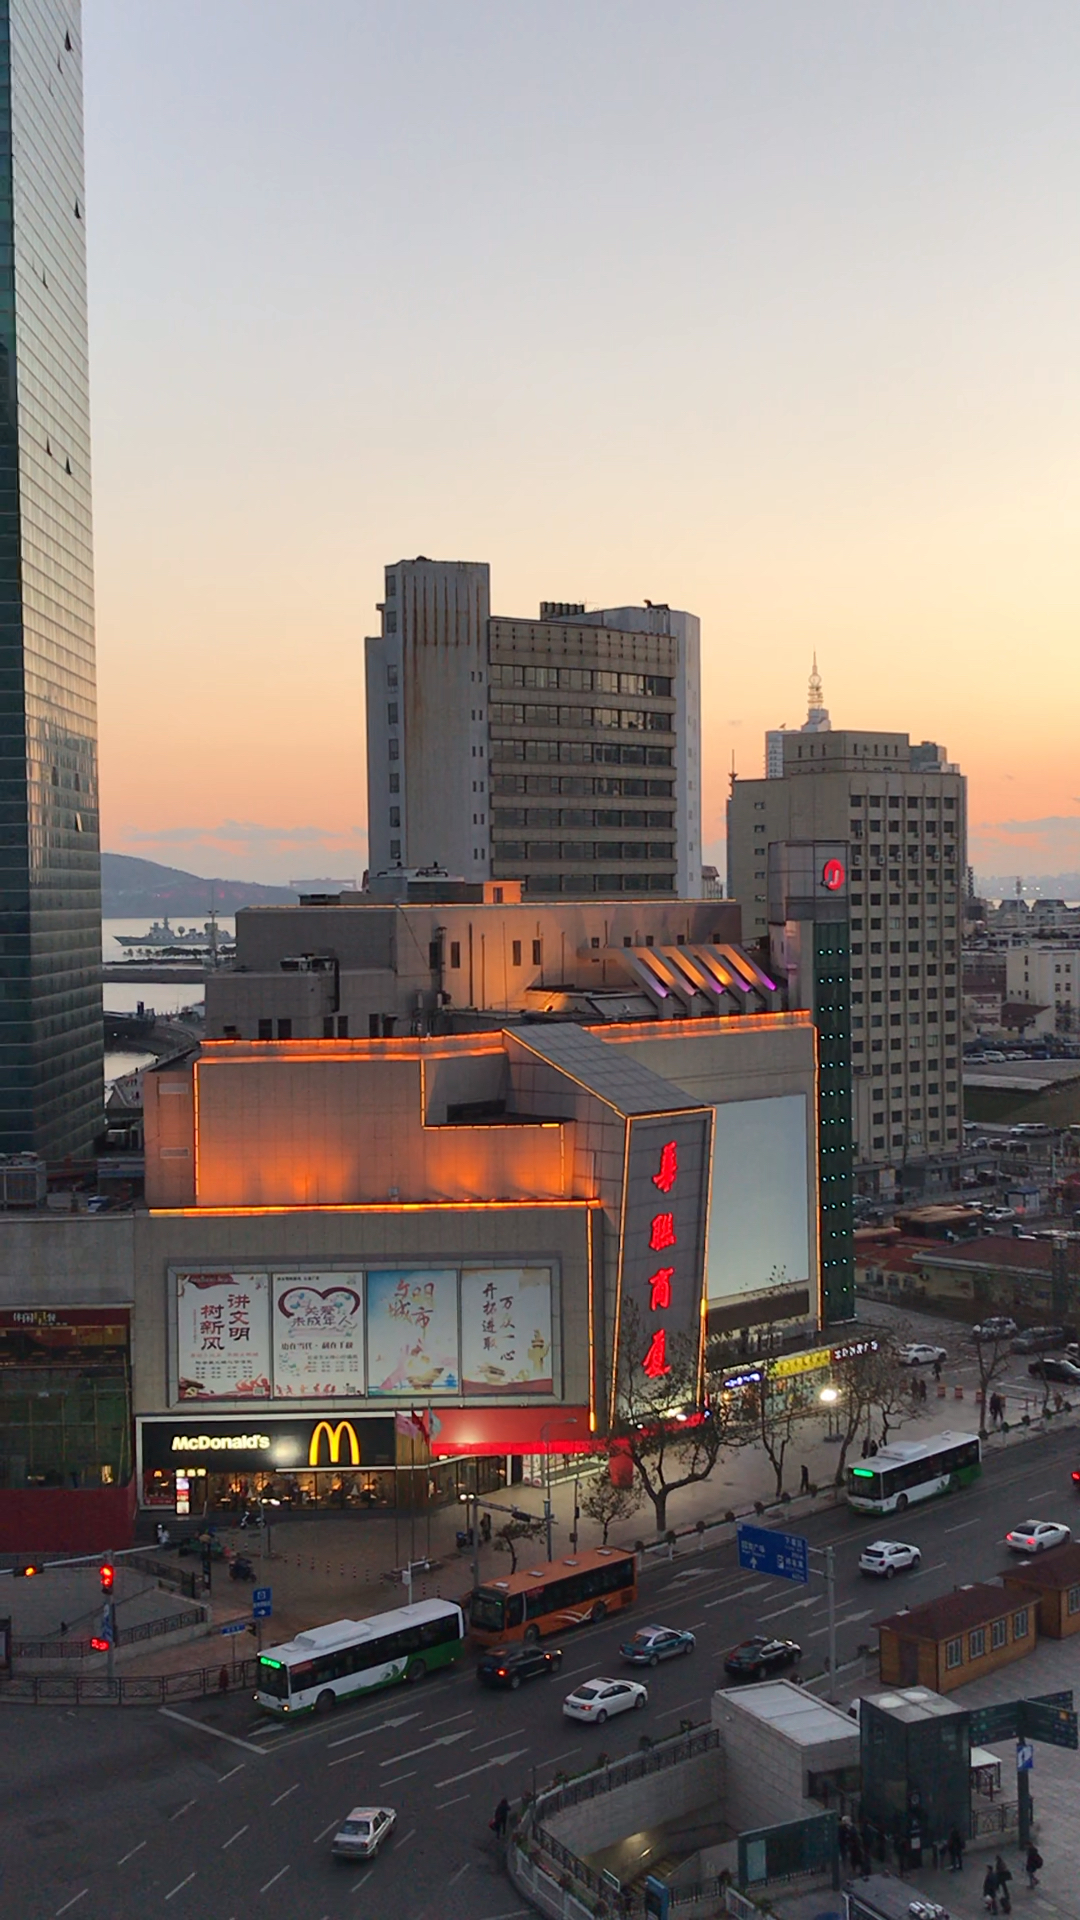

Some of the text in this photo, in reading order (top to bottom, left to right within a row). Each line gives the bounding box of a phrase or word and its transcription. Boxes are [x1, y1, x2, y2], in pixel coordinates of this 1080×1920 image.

[200, 1304, 226, 1350] 树新风
[227, 1294, 250, 1341] 讲文明
[500, 1296, 515, 1361] 万众一心
[171, 1434, 271, 1451] McDonald's
